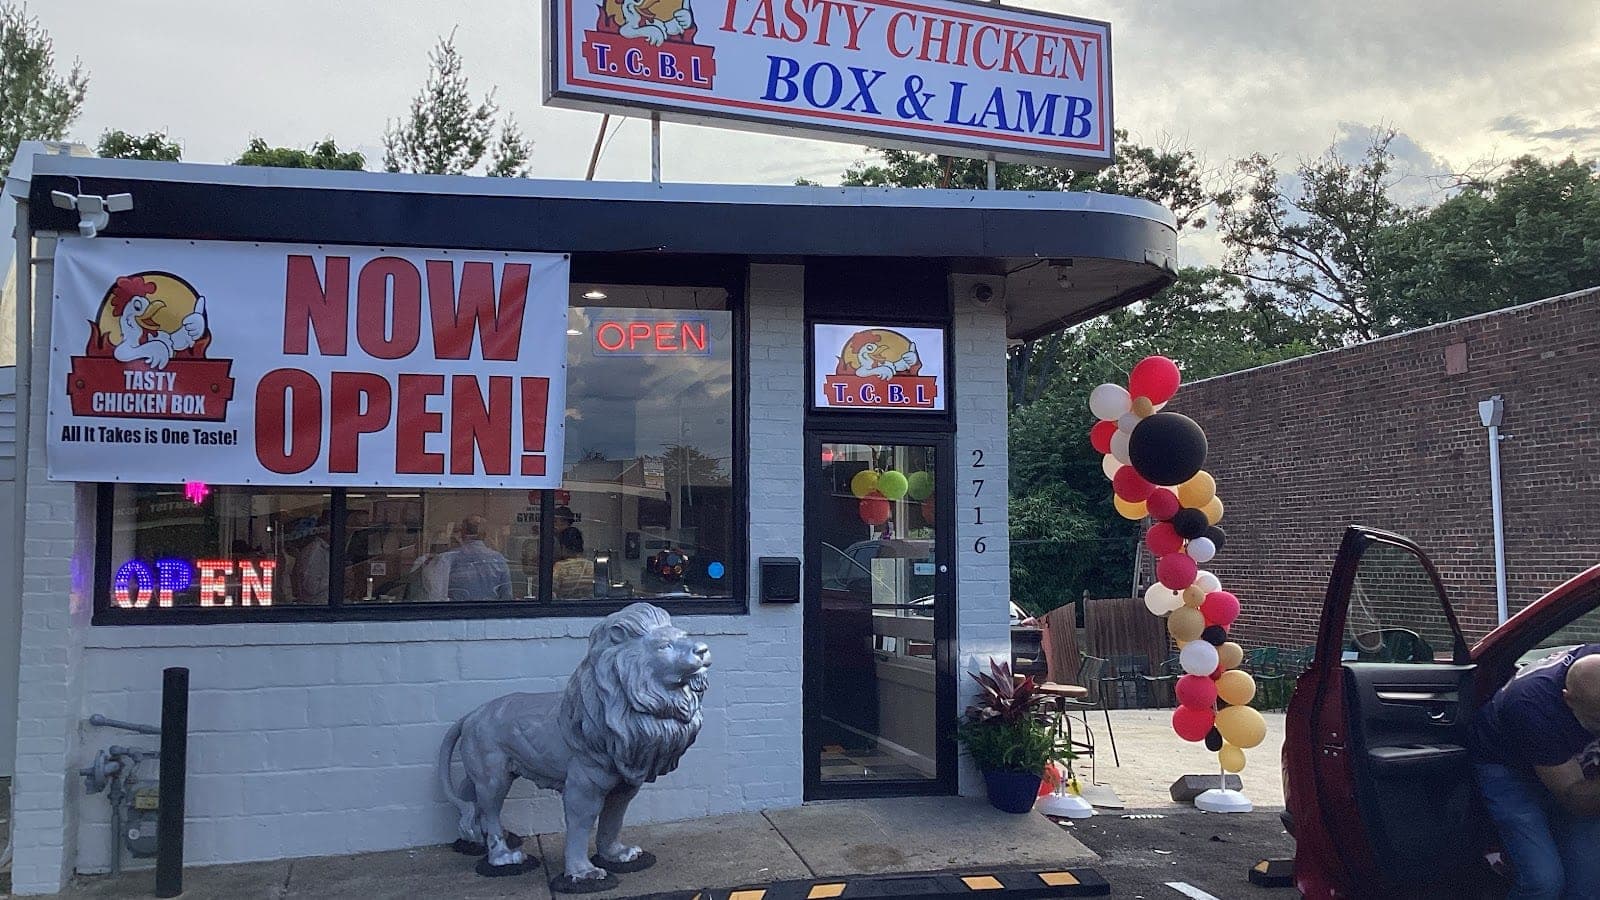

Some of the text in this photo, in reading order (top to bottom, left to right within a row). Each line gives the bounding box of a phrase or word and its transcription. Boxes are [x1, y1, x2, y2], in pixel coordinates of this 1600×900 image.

[719, 0, 1092, 82] TASTY CHICKEN
[760, 55, 1092, 139] BOX & LAMB
[283, 255, 532, 361] NOW
[597, 321, 706, 350] OPEN
[92, 392, 206, 415] CHICKEN BOX
[123, 370, 177, 392] TASTY
[61, 425, 238, 445] All It Takes is One Taste!
[255, 368, 550, 476] OPEN!
[115, 558, 277, 608] OPEN
